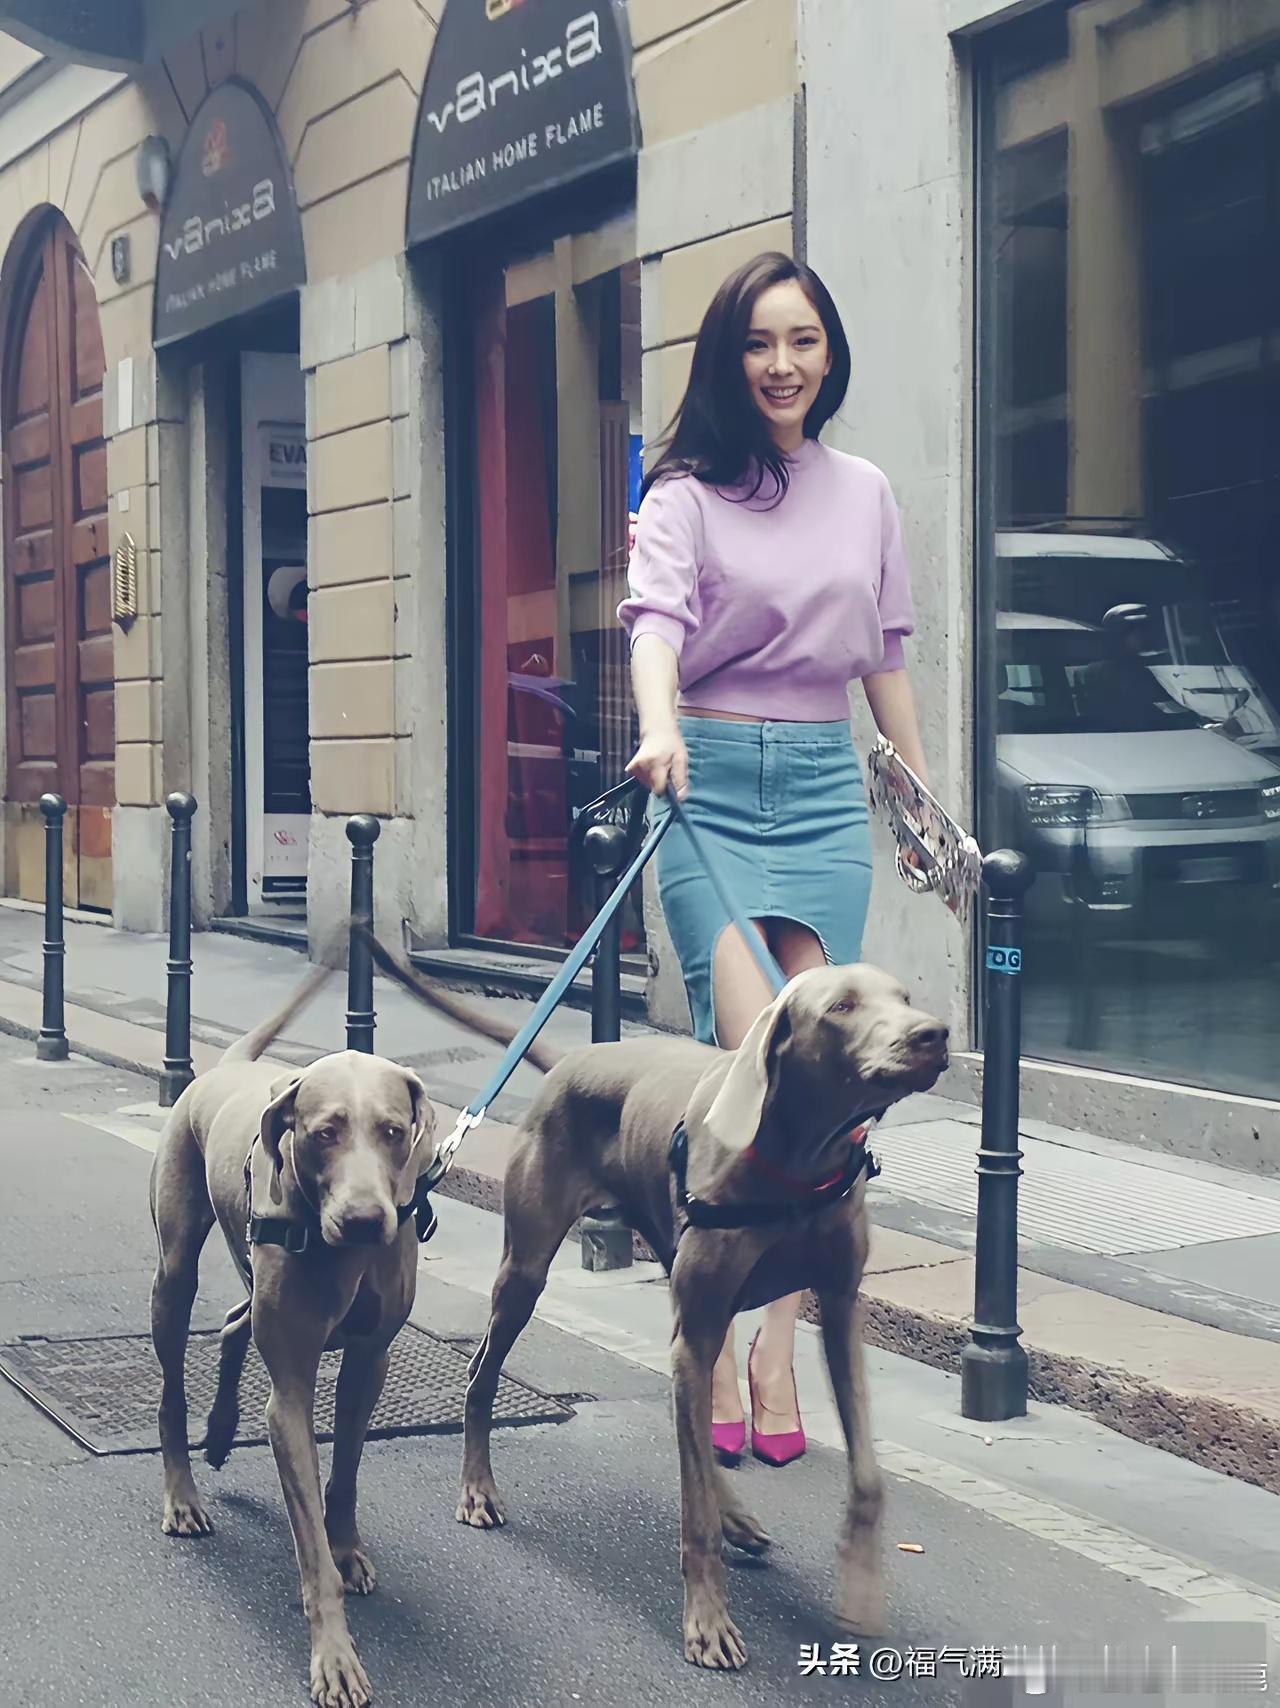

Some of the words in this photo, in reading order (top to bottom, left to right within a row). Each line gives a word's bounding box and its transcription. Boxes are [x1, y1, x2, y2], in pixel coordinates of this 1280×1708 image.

[427, 10, 602, 133] vanixa
[427, 157, 486, 200] ITALIAN
[492, 132, 538, 171] HOME
[545, 102, 604, 149] FLAME
[164, 178, 275, 260] vanixa
